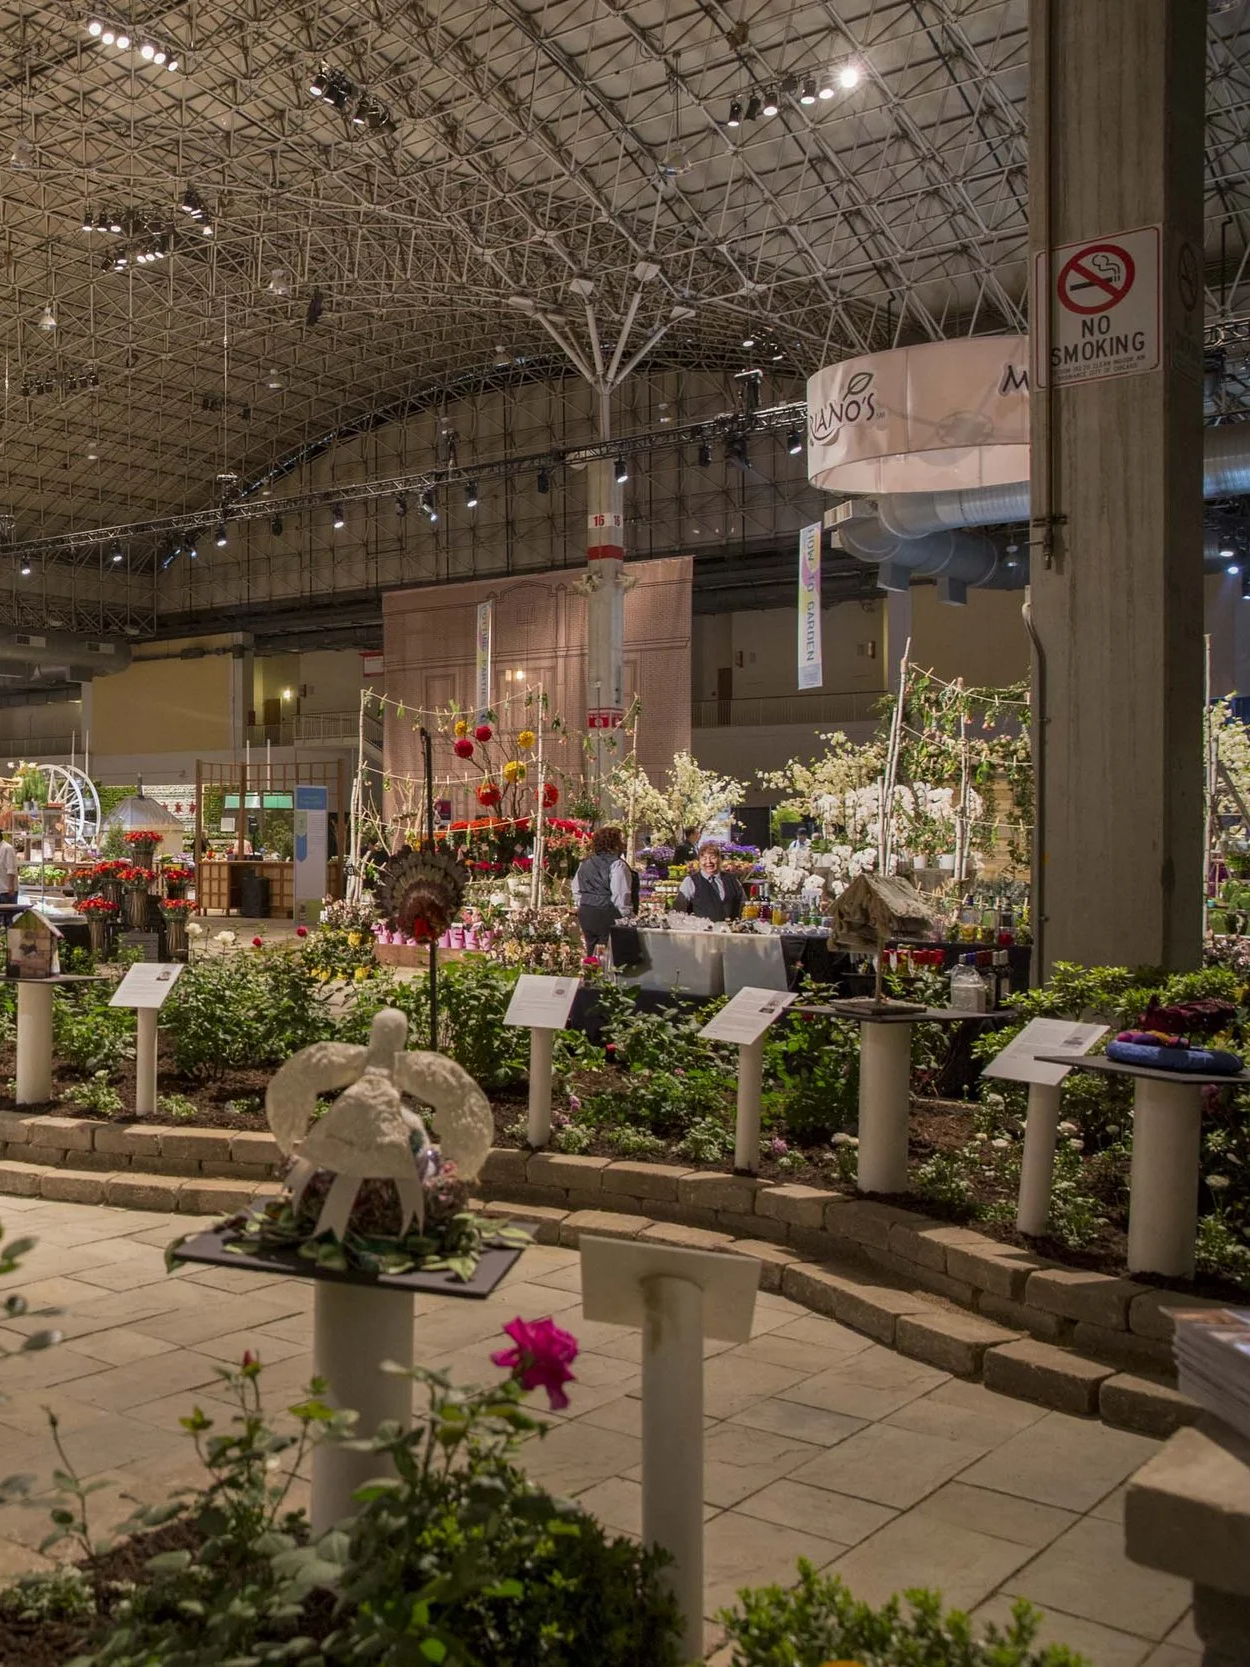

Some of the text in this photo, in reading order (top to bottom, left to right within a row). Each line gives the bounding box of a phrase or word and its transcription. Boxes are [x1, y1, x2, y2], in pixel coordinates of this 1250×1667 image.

[1081, 315, 1110, 339] NO
[1051, 331, 1145, 367] SMOKING
[593, 514, 605, 527] 16
[807, 528, 815, 561] HOW
[807, 573, 815, 593] TO
[806, 600, 815, 662] GARDEN
